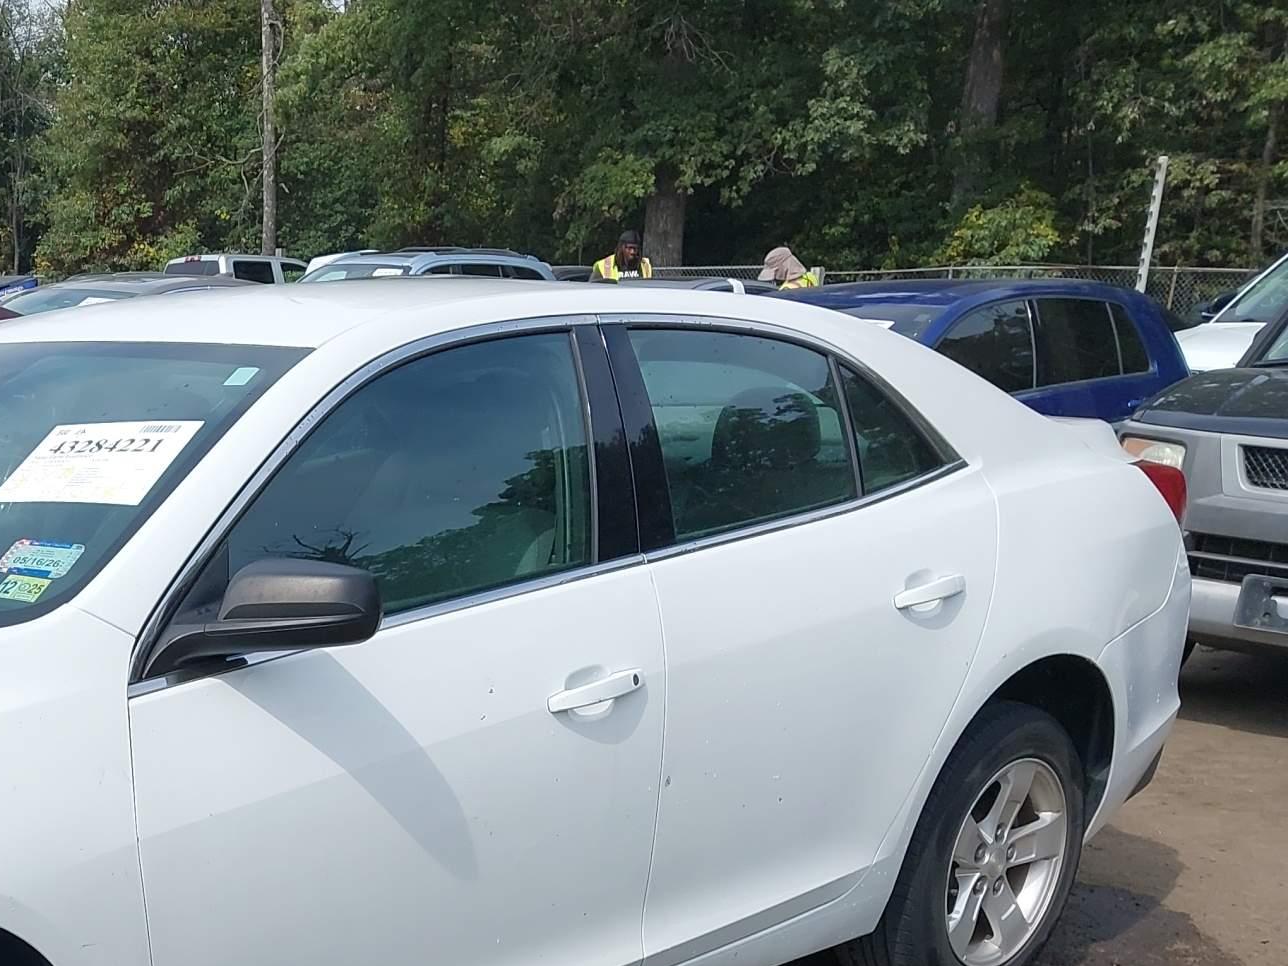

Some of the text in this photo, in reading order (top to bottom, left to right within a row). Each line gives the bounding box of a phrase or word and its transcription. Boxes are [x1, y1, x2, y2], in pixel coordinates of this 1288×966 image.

[49, 438, 165, 454] 43284221
[0, 580, 45, 594] 12 25
